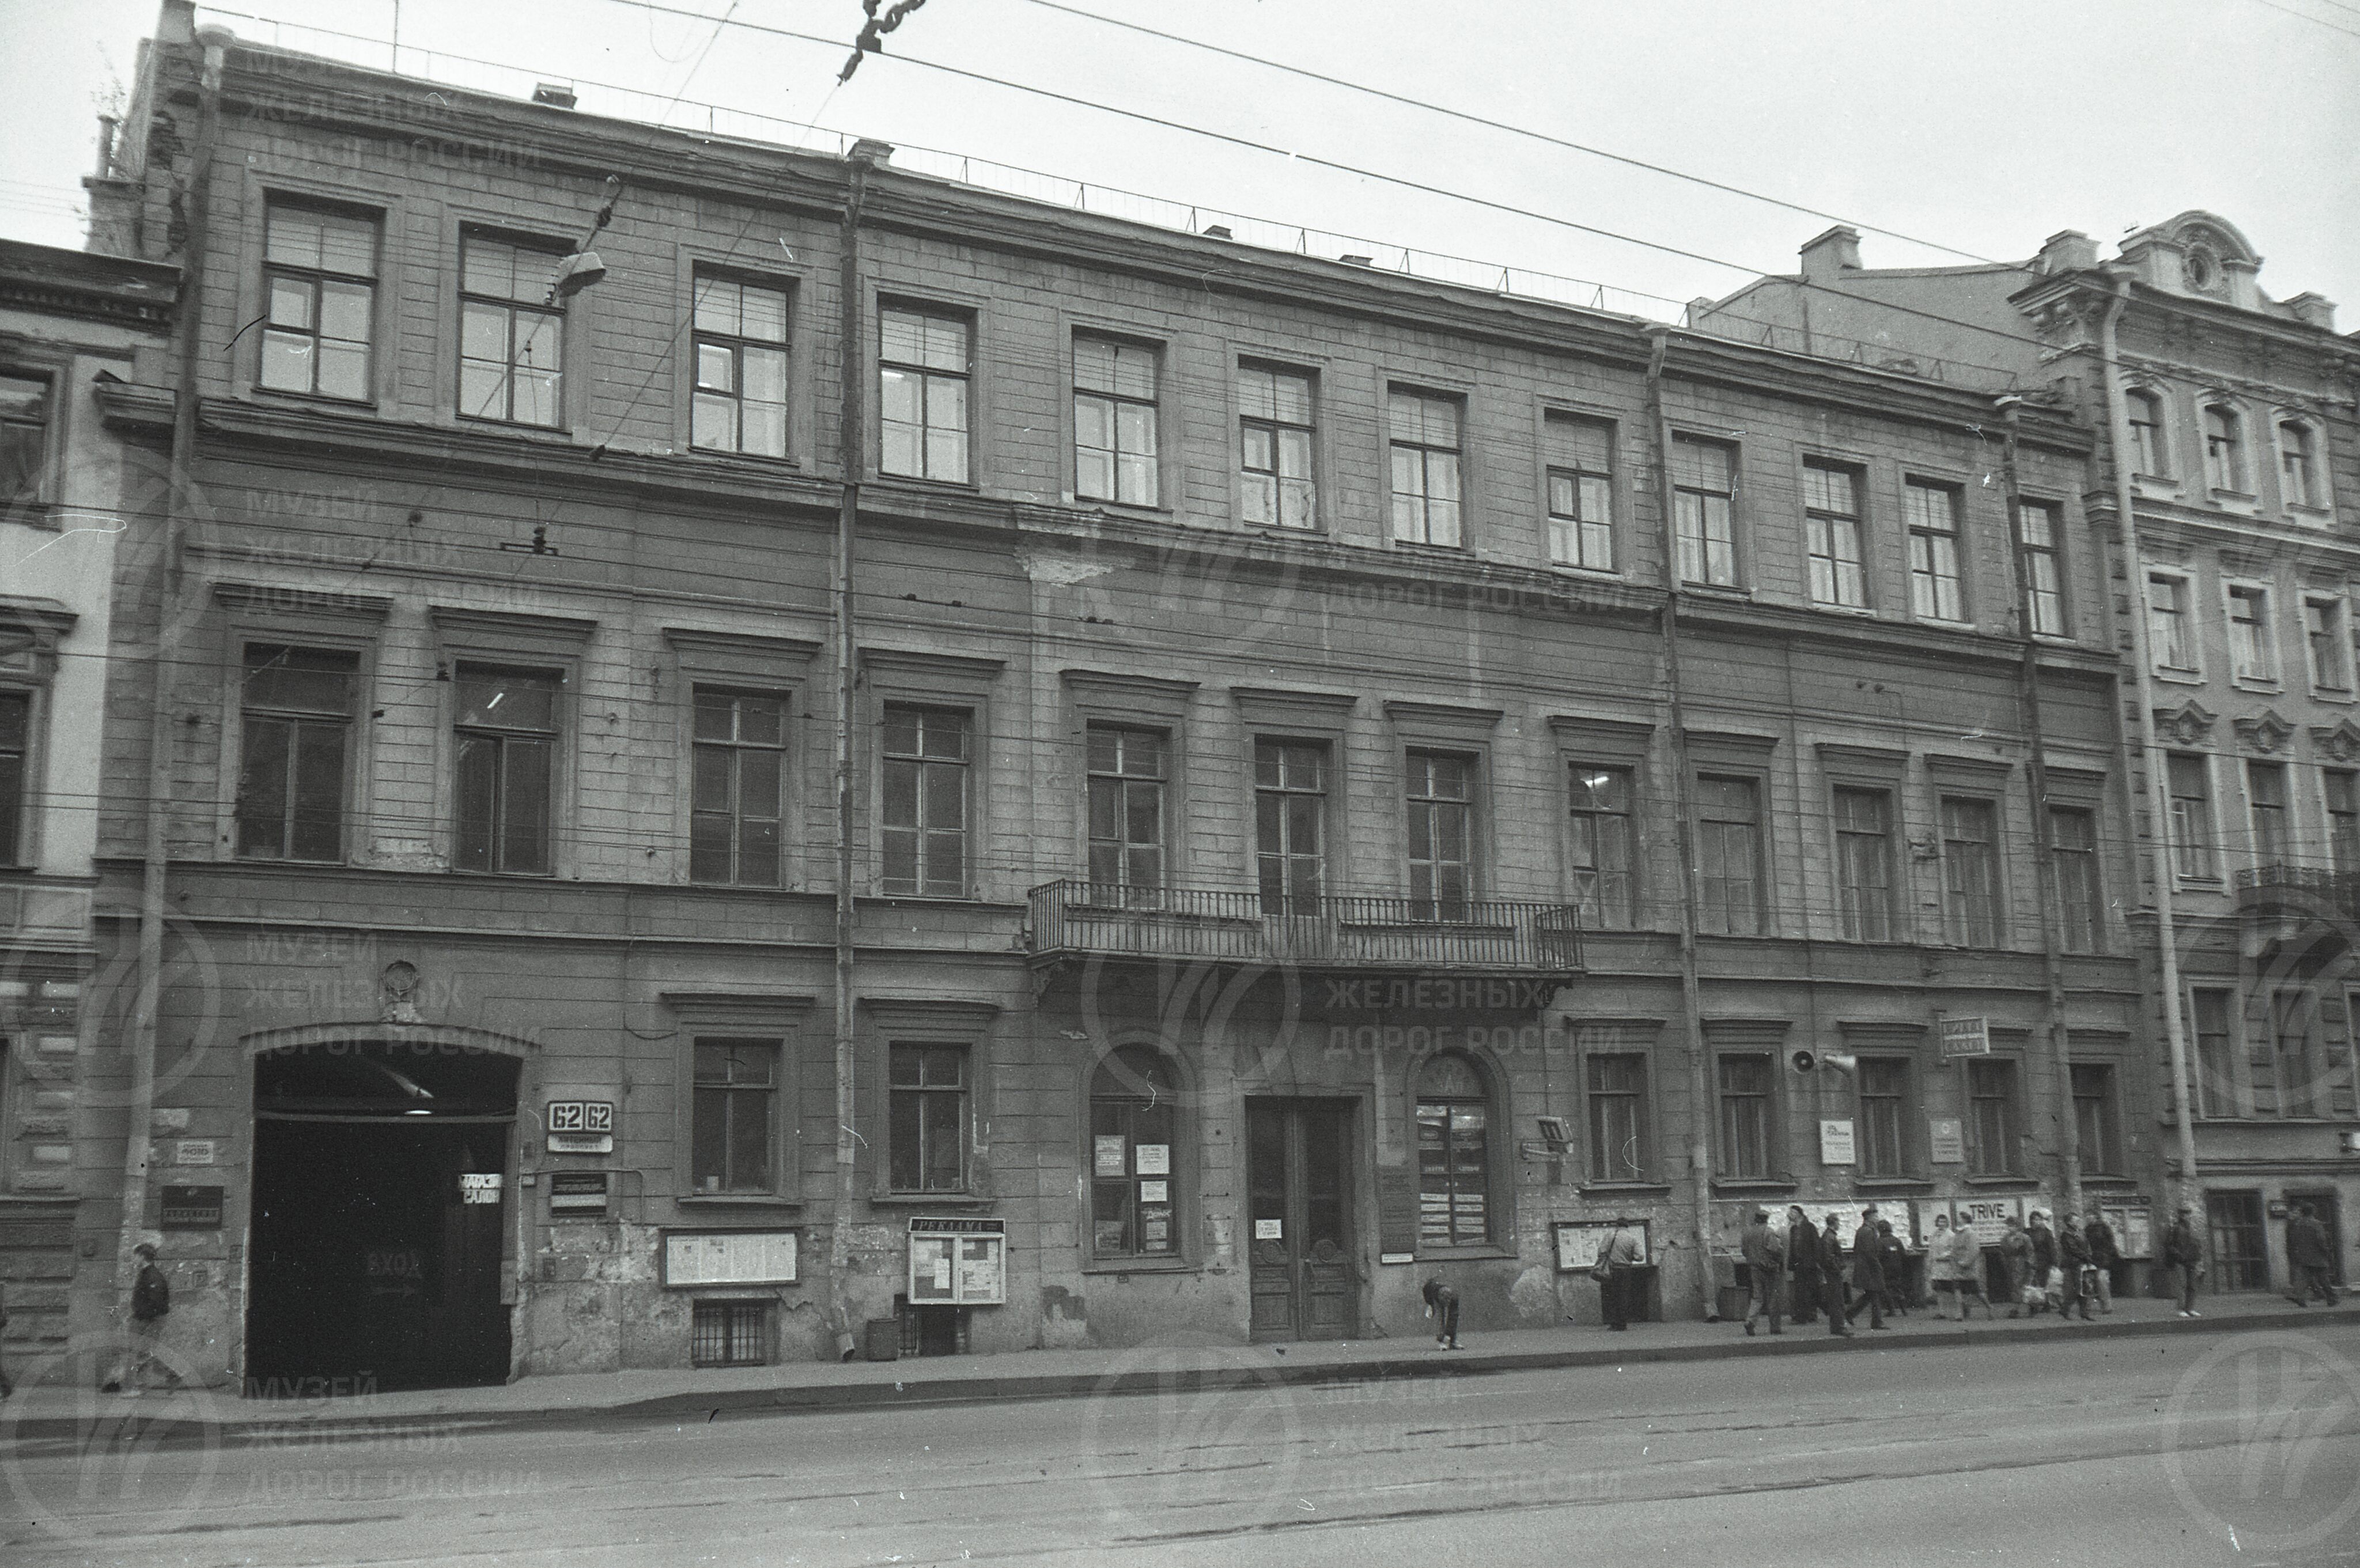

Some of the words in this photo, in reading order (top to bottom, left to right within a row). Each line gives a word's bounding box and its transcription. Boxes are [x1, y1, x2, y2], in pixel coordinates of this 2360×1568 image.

[553, 1105, 580, 1128] 62
[588, 1105, 610, 1128] 62
[918, 1220, 983, 1232] РЕКЛАМА
